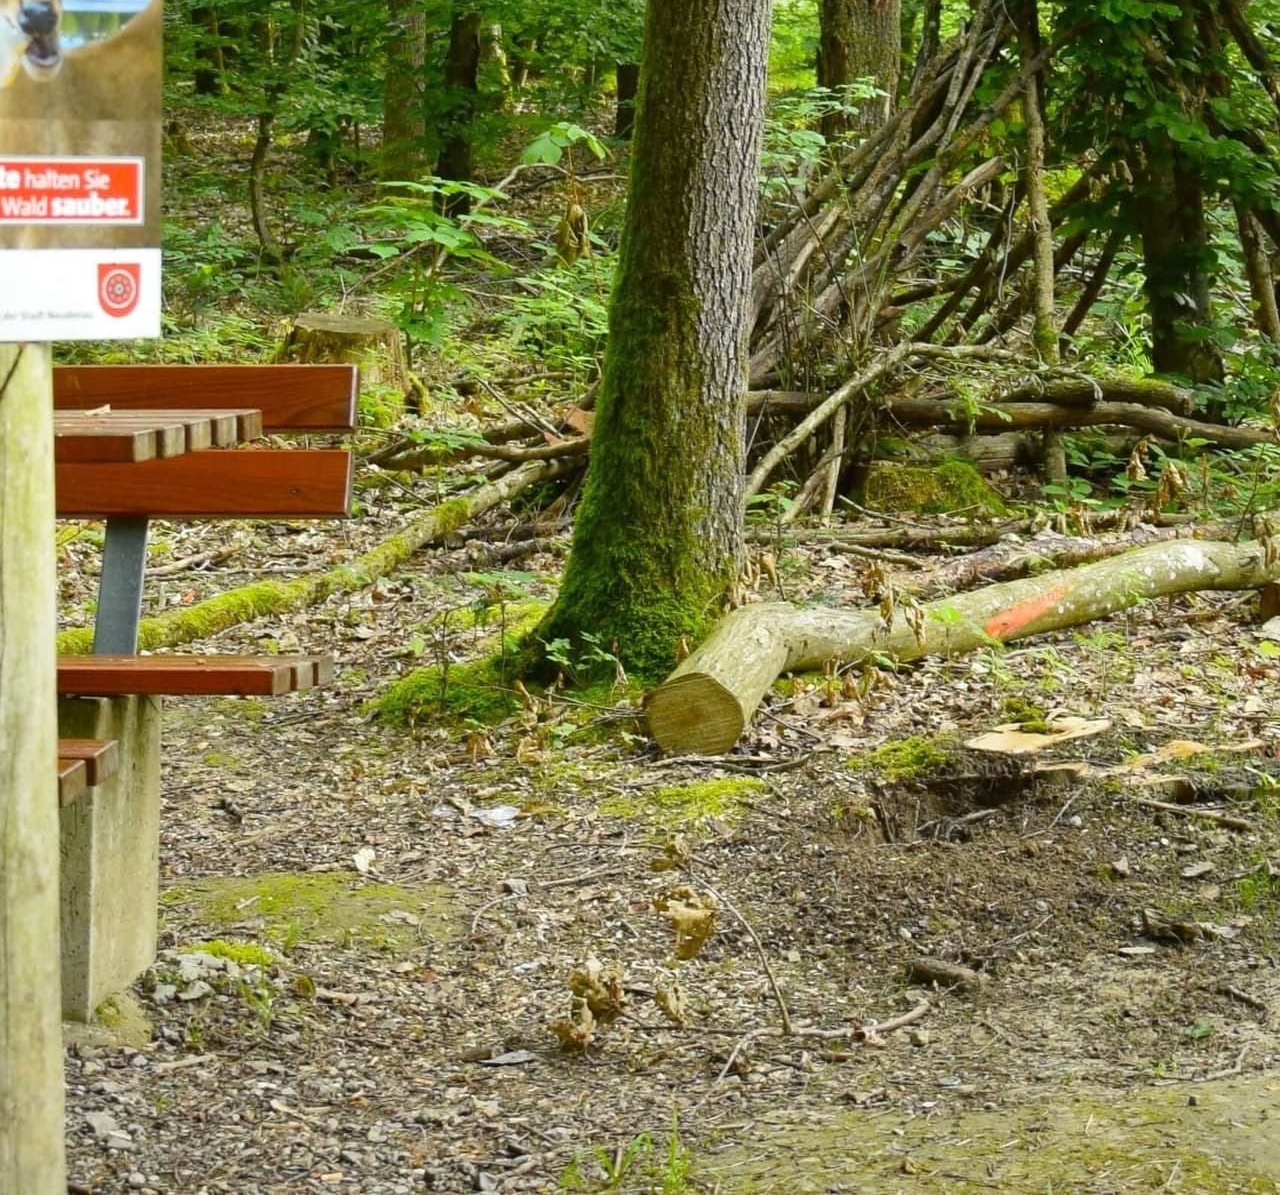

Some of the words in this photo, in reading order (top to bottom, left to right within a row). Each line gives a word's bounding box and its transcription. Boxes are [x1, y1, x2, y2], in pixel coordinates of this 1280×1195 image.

[24, 168, 80, 189] halten
[84, 169, 111, 189] Sie
[1, 196, 48, 216] Wald
[51, 190, 132, 216] sauber.
